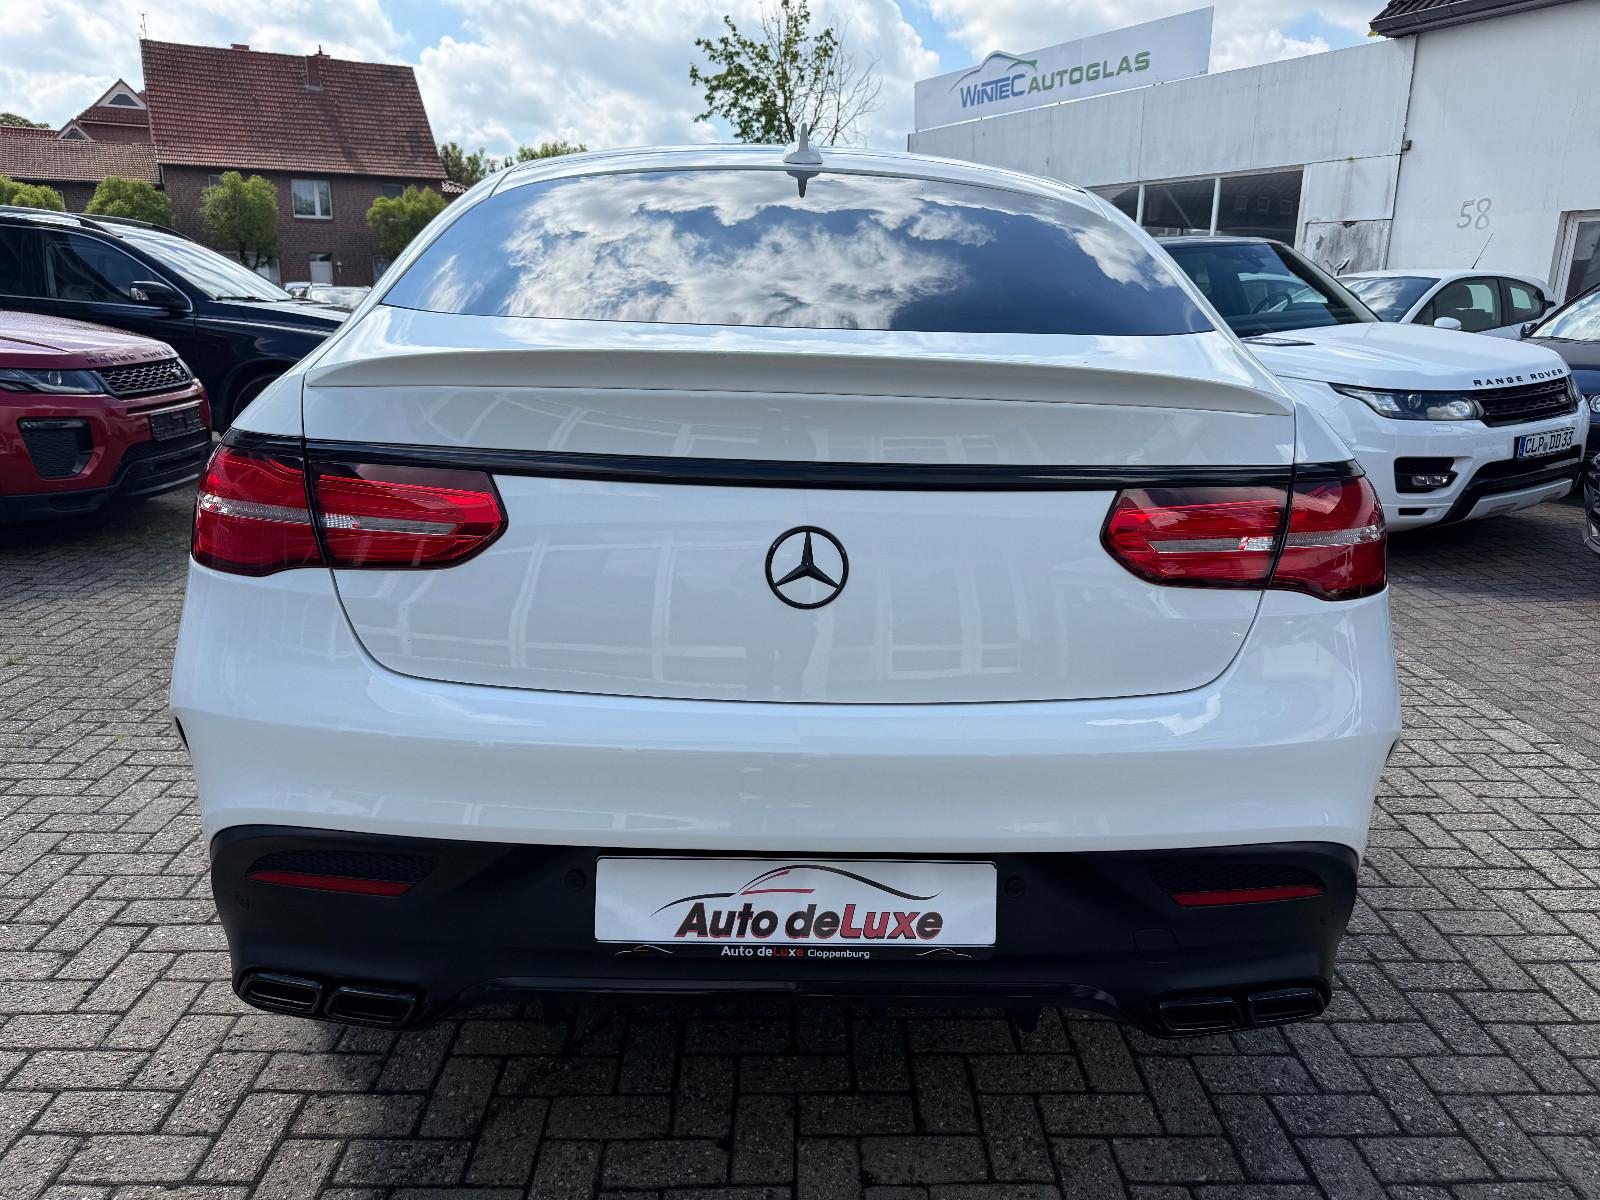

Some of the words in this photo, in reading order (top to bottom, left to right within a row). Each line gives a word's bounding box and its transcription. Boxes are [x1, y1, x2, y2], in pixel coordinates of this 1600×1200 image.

[1027, 51, 1151, 94] AUTOGLAS
[1456, 197, 1492, 230] 58
[1473, 375, 1523, 386] RANGE
[1530, 368, 1564, 380] ROVER
[1525, 436, 1545, 453] CLP
[1549, 433, 1562, 450] DD
[1561, 430, 1573, 447] 33
[674, 902, 778, 939] Auto
[785, 903, 943, 940] deLuxe
[721, 946, 754, 957] Auto
[757, 946, 804, 957] deLuxe
[807, 949, 870, 960] Cloppenburg
